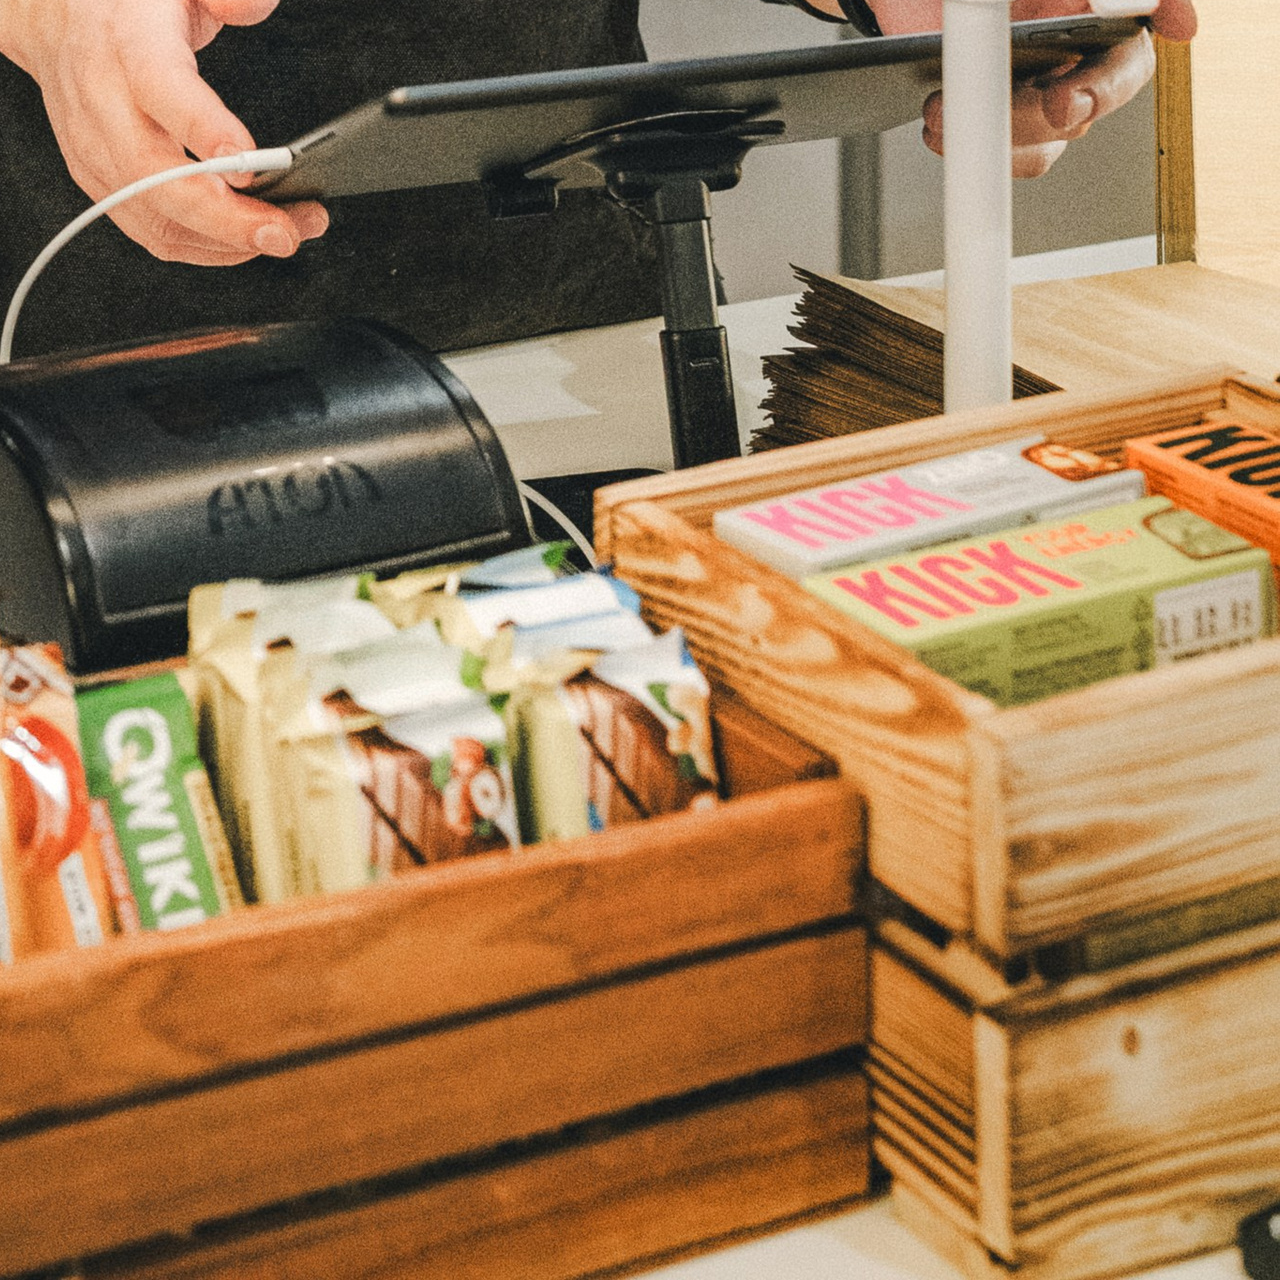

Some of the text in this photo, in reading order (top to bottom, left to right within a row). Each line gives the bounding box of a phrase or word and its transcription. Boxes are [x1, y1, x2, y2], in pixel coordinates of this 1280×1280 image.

[1156, 425, 1280, 498] KIC
[743, 473, 976, 551] KICK
[831, 539, 1083, 629] KICK
